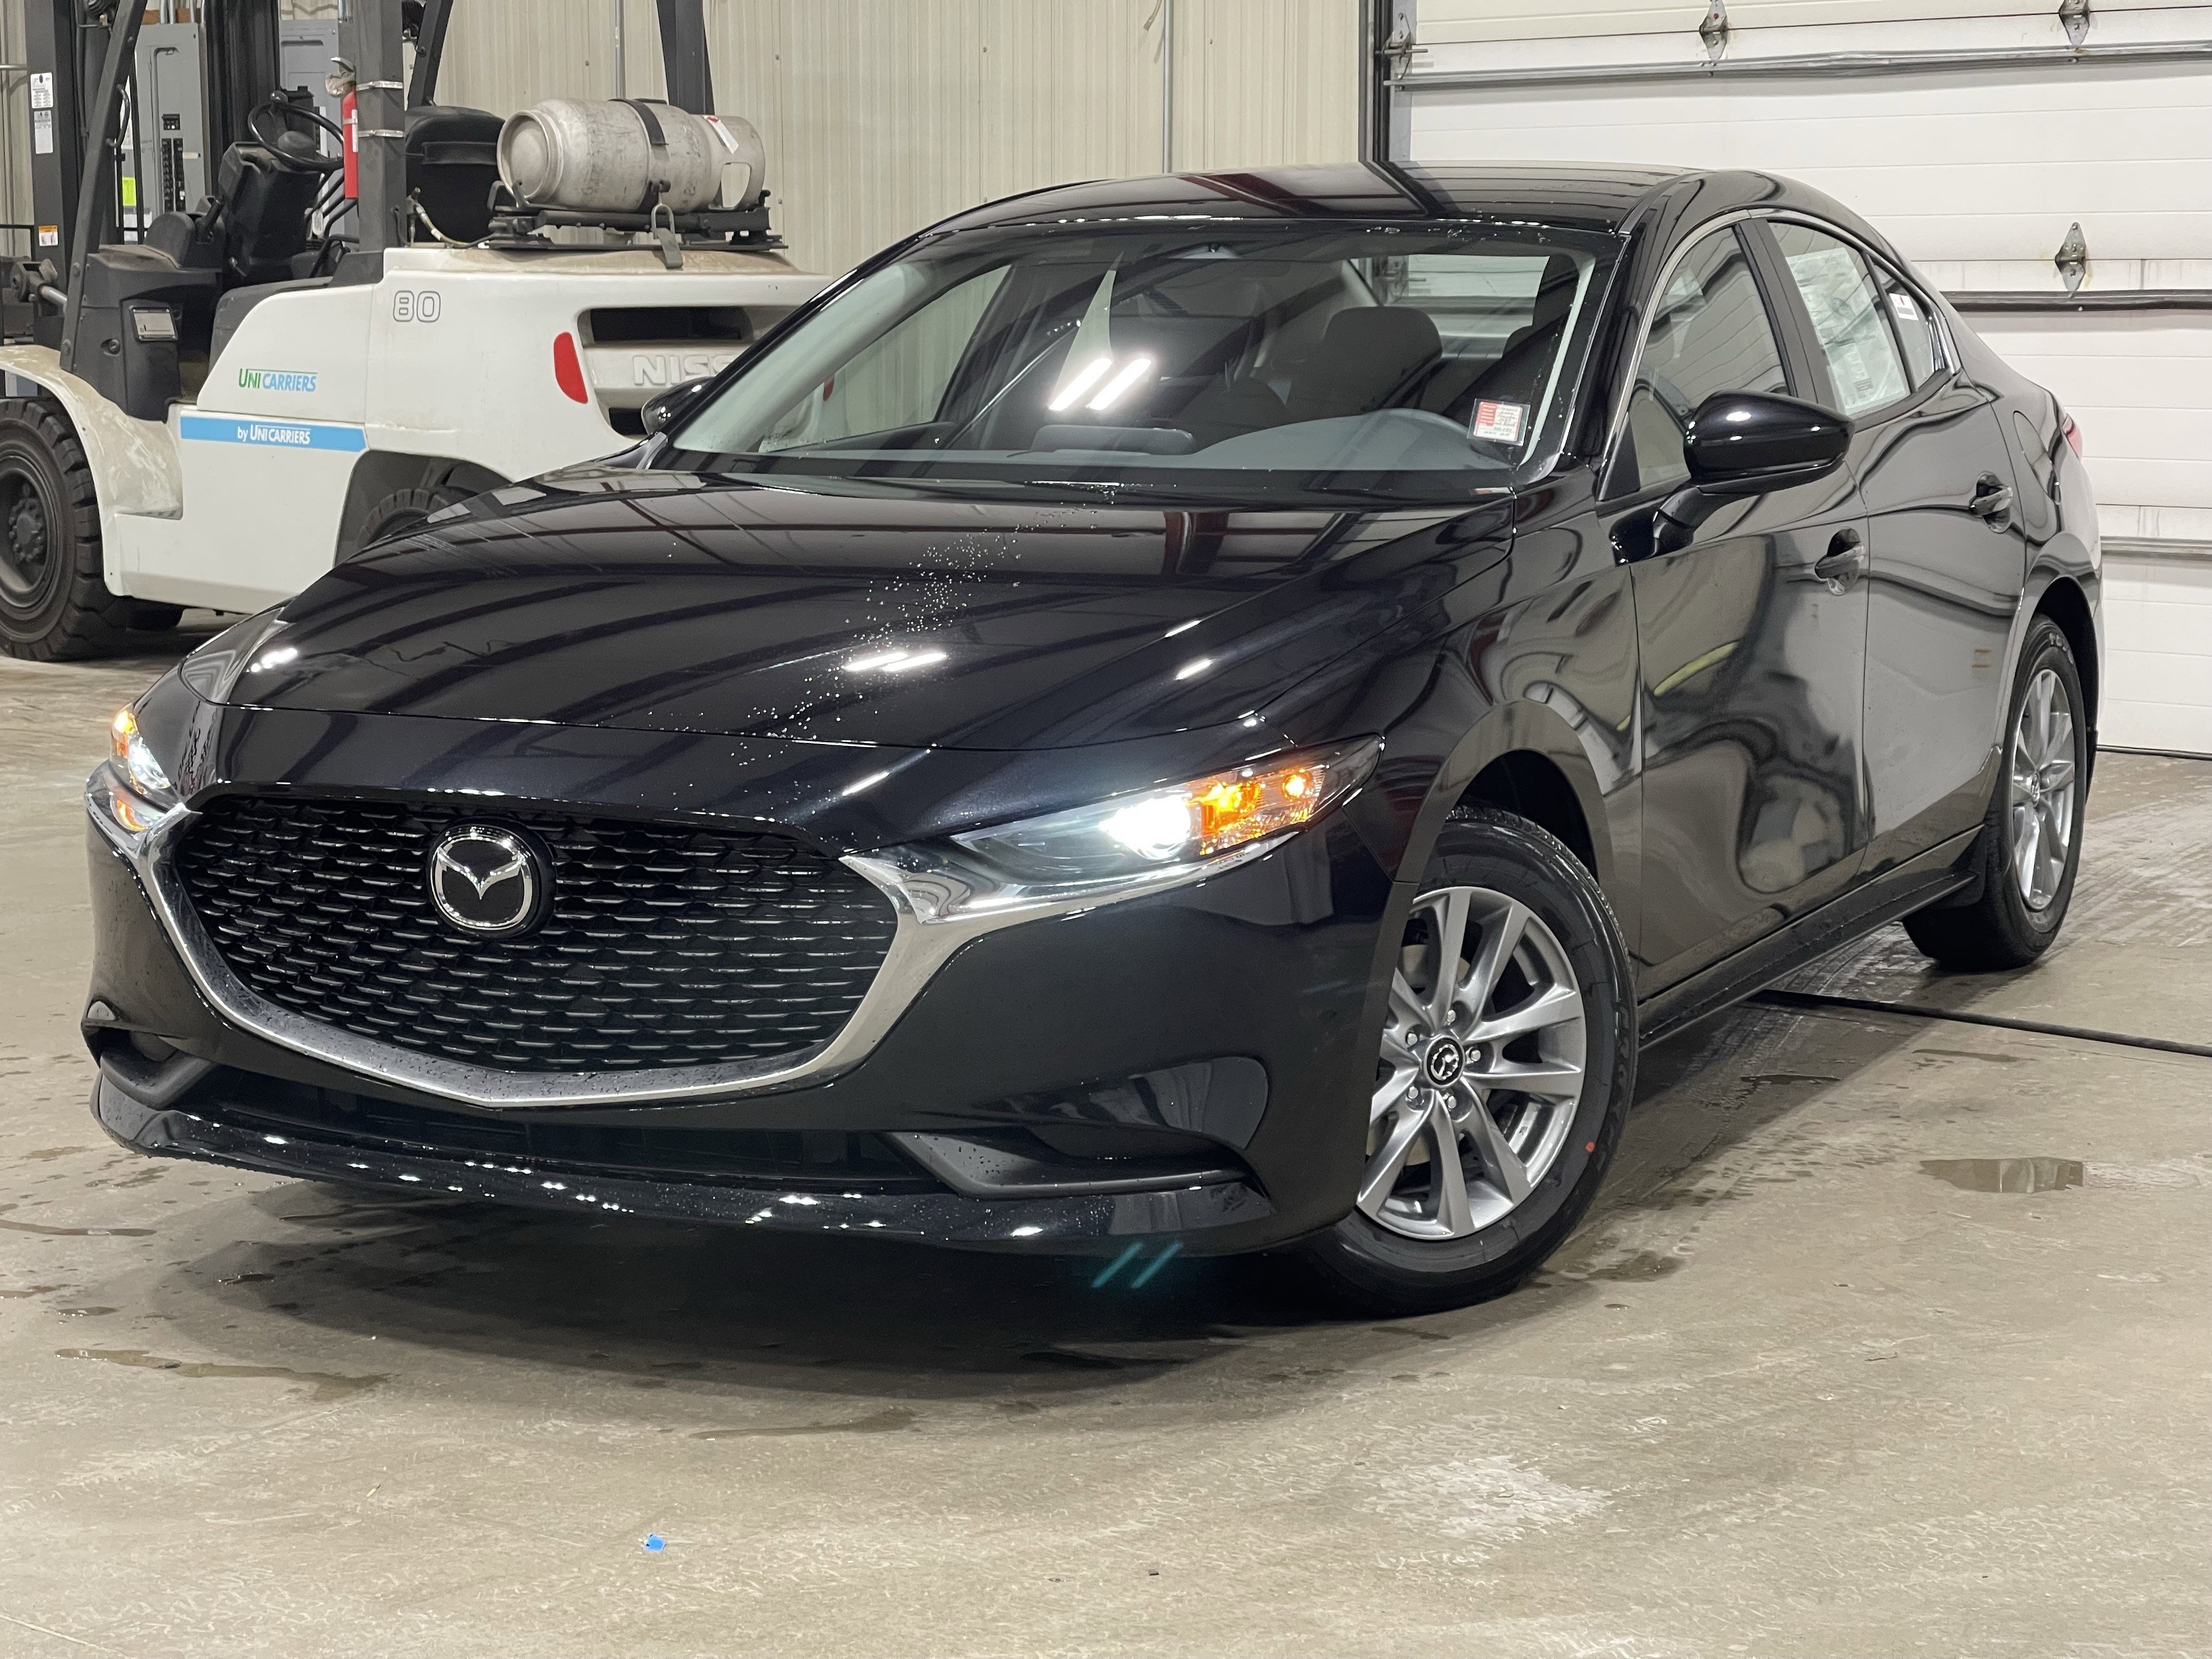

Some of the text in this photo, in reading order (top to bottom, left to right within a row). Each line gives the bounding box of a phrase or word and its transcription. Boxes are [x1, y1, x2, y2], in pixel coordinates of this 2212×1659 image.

[393, 290, 441, 323] 80
[237, 424, 311, 444] by UNICARRIERS
